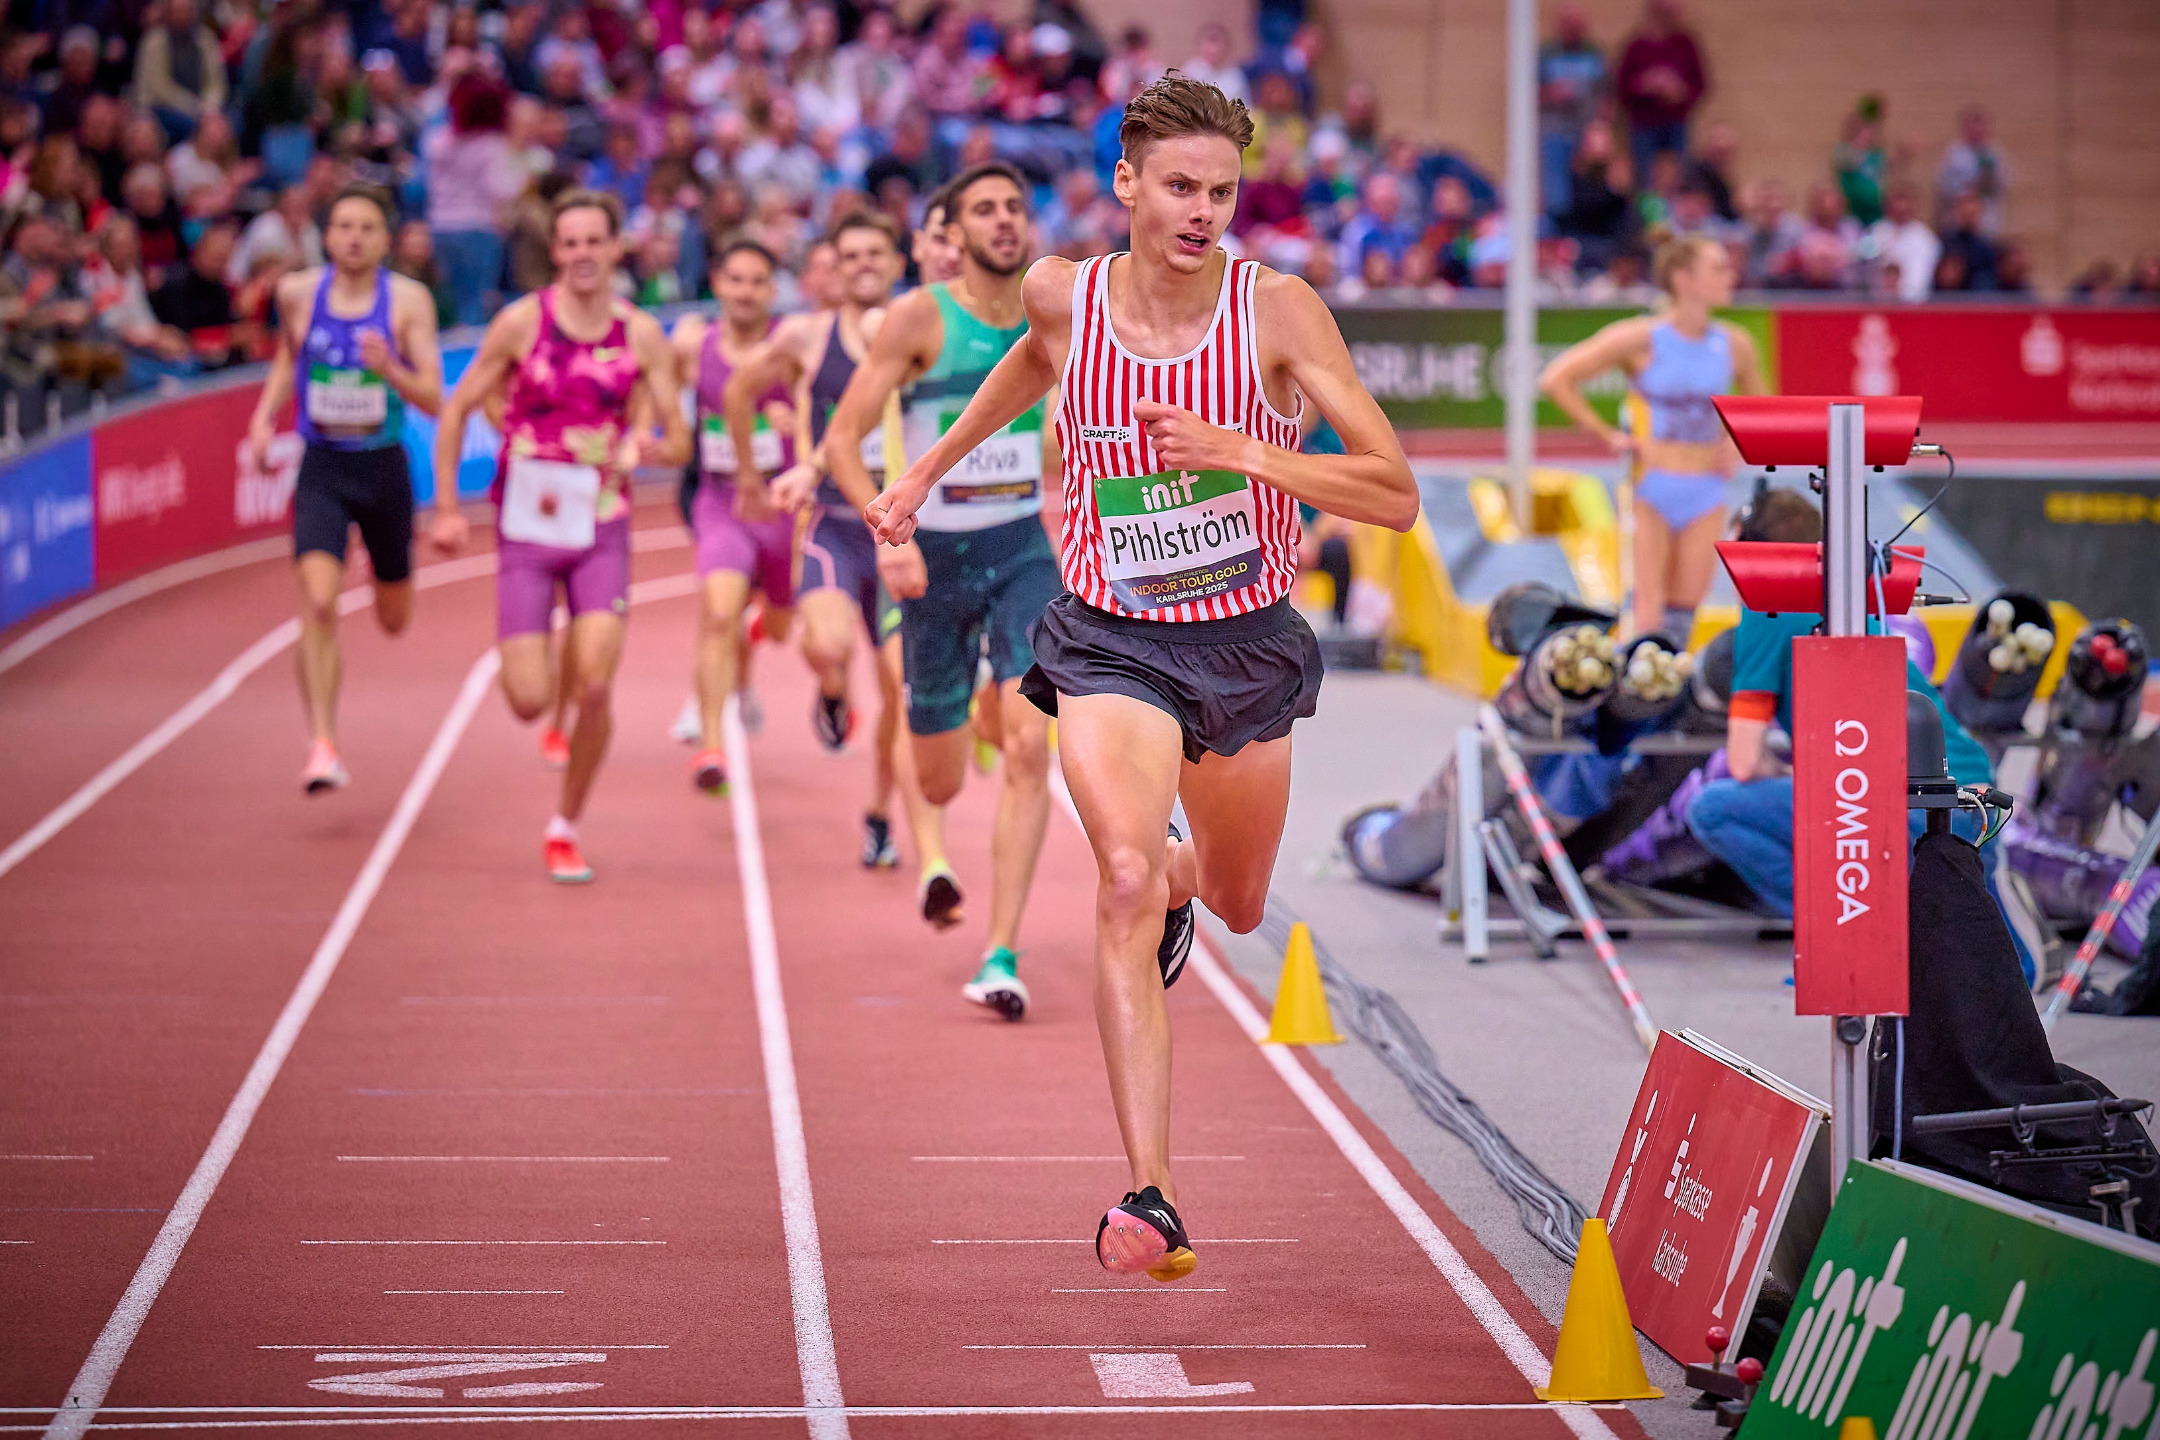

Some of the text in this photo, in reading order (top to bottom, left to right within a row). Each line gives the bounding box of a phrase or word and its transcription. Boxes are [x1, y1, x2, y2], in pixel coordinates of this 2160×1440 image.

[967, 446, 1021, 474] Riva
[1082, 429, 1117, 439] CRAFT
[1141, 470, 1200, 511] init
[1109, 509, 1251, 565] Pihlström
[1129, 562, 1248, 597] INDOOR TOUR GOLD
[1155, 581, 1228, 604] KARLSRUHE 2025
[1835, 768, 1870, 925] OMEGA
[1673, 1163, 1713, 1222] Sparkasse
[1652, 1228, 1688, 1288] Karlsruhe
[1769, 1237, 1908, 1428] init
[1884, 1279, 2026, 1440] init
